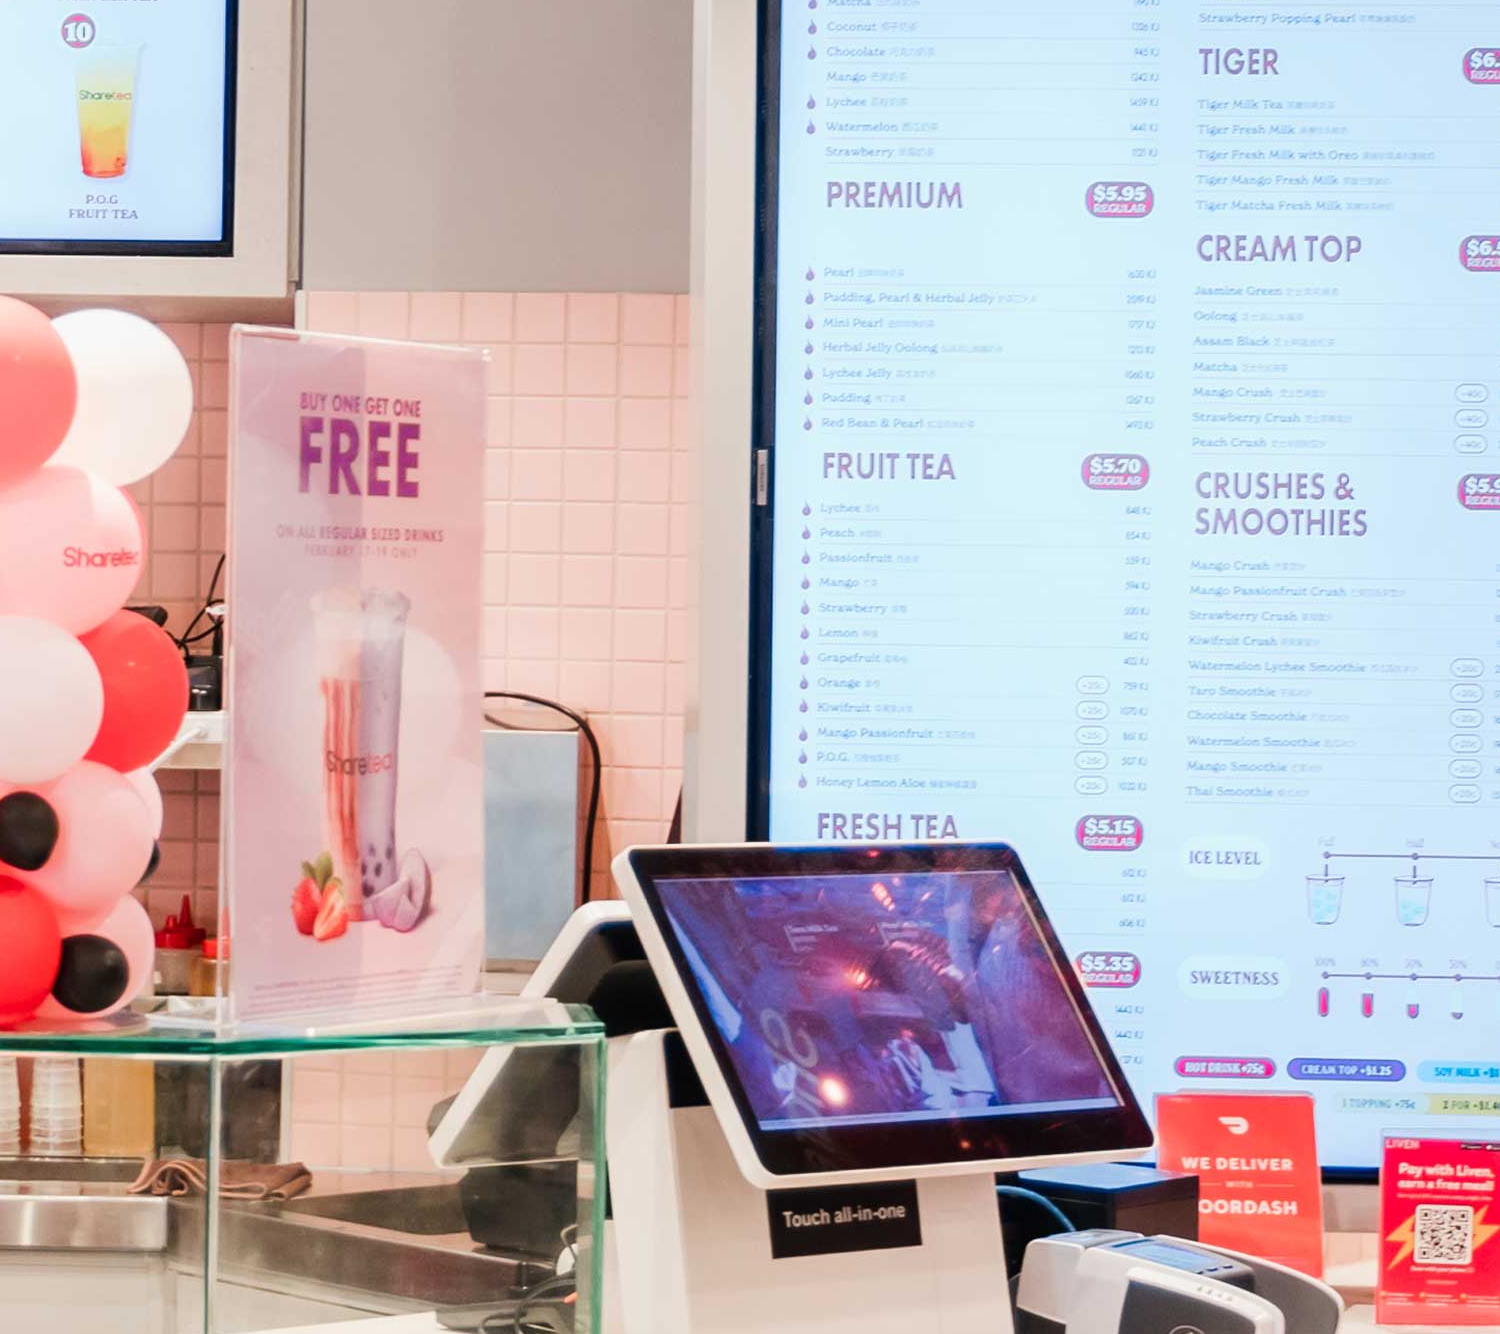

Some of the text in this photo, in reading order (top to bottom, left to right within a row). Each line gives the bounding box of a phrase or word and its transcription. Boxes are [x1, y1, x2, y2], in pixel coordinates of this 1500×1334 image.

[65, 22, 92, 42] 10
[827, 22, 876, 31] Coconut
[827, 47, 886, 57] Chocolate
[1199, 49, 1279, 74] TIGER
[826, 72, 866, 83] Mango
[80, 90, 132, 101] Sharetea
[826, 97, 867, 107] Lychee
[1198, 100, 1228, 111] Tiger
[1232, 100, 1257, 109] Milk
[1262, 100, 1283, 109] Tea
[826, 122, 898, 132] Watermelon
[825, 147, 893, 158] Strawberry
[826, 182, 963, 208] PREMIUM
[1093, 184, 1147, 203] $5.95
[68, 209, 138, 219] FRUIT TEA
[1197, 235, 1361, 261] CREAM TOP
[1194, 312, 1237, 322] Oolong
[301, 392, 421, 417] BUY ONE GET ONE
[298, 416, 420, 498] FREE
[823, 453, 955, 480] FRUIT TEA
[1090, 458, 1141, 475] $5.70
[1196, 473, 1354, 500] CRUSHES &
[1195, 508, 1367, 536] SMOOTHIES
[319, 527, 367, 540] REGULAR
[372, 529, 400, 541] SIZED
[405, 529, 443, 542] DRINKS
[819, 553, 892, 563] Passionfruit
[327, 750, 392, 776] Sharetea
[818, 813, 958, 839] FRESH TEA
[1085, 819, 1135, 836] $5.15
[1189, 851, 1261, 866] ICE LEVEL
[1082, 954, 1134, 972] $5.35
[1190, 971, 1280, 985] SWEETNESS
[1301, 1065, 1335, 1074] CREAM
[1339, 1066, 1357, 1074] TOP
[1435, 1067, 1453, 1077] SOY
[1182, 1157, 1292, 1171] WE DELIVER
[1399, 1163, 1423, 1177] Pay
[1426, 1164, 1453, 1175] with
[1398, 1179, 1424, 1188] earn
[1436, 1179, 1460, 1189] free
[782, 1203, 905, 1229] Touch all-in-one
